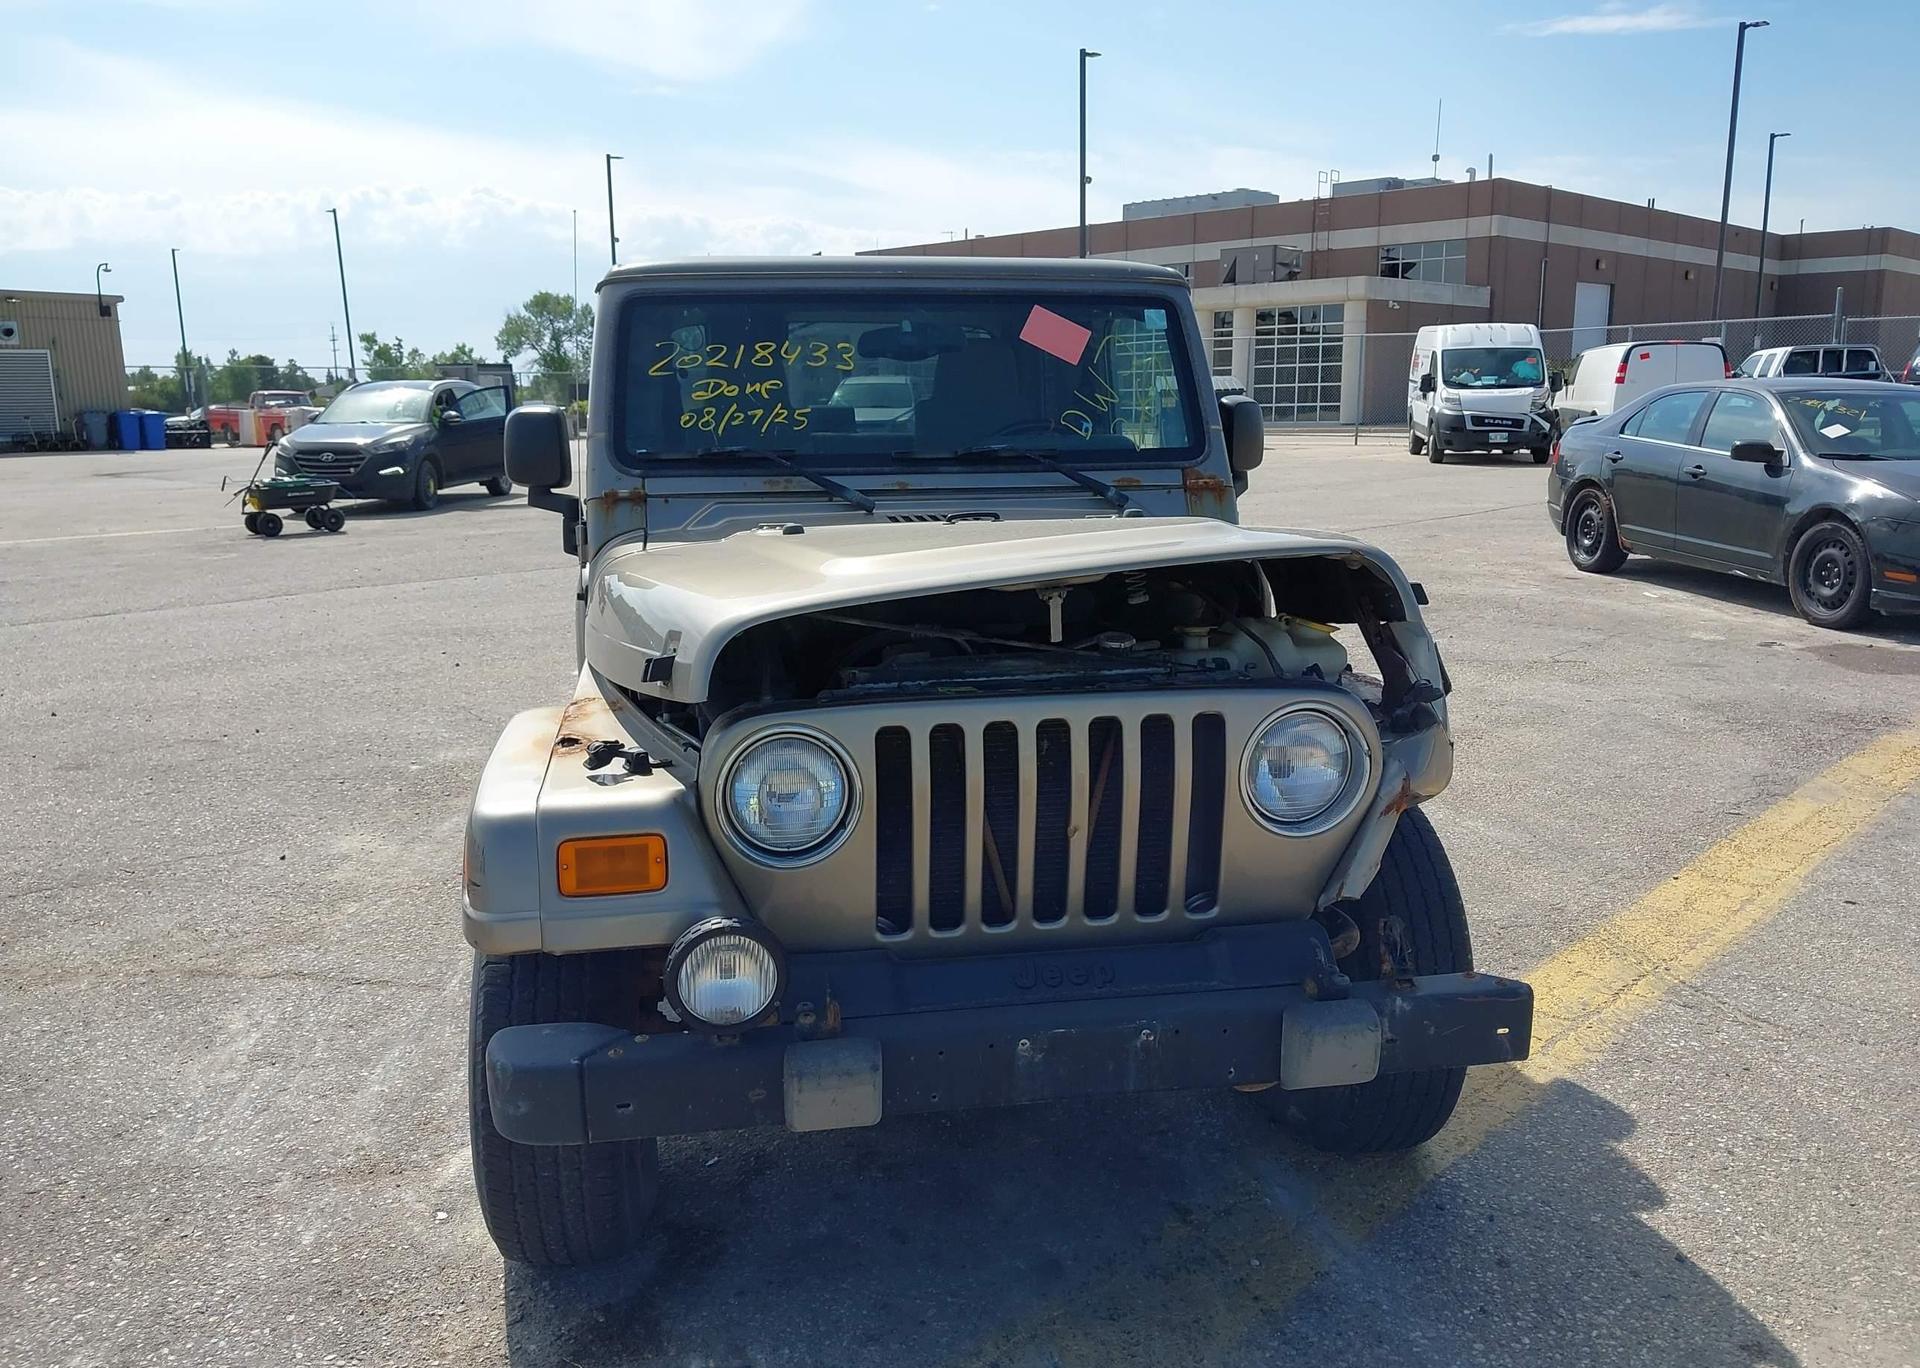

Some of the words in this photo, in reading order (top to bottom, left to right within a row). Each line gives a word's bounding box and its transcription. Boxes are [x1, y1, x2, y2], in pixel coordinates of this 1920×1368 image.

[648, 340, 855, 376] 20218433
[679, 403, 812, 437] 08/27/25
[1015, 958, 1116, 990] Jeep
